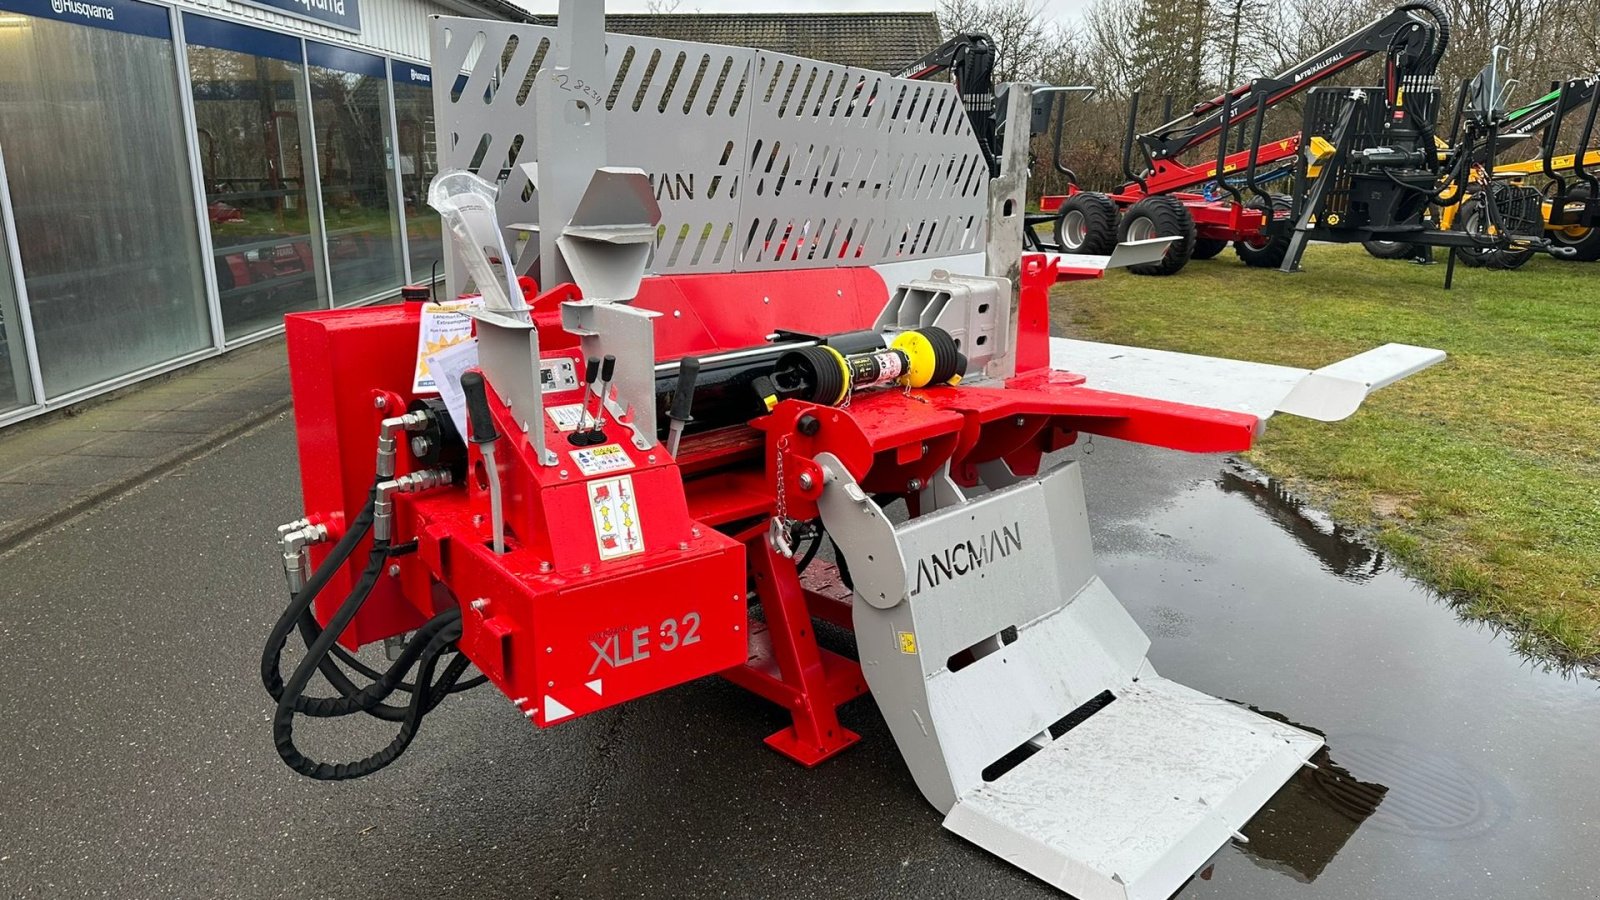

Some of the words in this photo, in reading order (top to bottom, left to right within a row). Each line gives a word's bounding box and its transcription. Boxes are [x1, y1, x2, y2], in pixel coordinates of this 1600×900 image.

[63, 0, 115, 20] Husqvarna
[911, 521, 1022, 596] ANCMAN
[588, 625, 651, 676] XLE
[659, 611, 701, 652] 32
